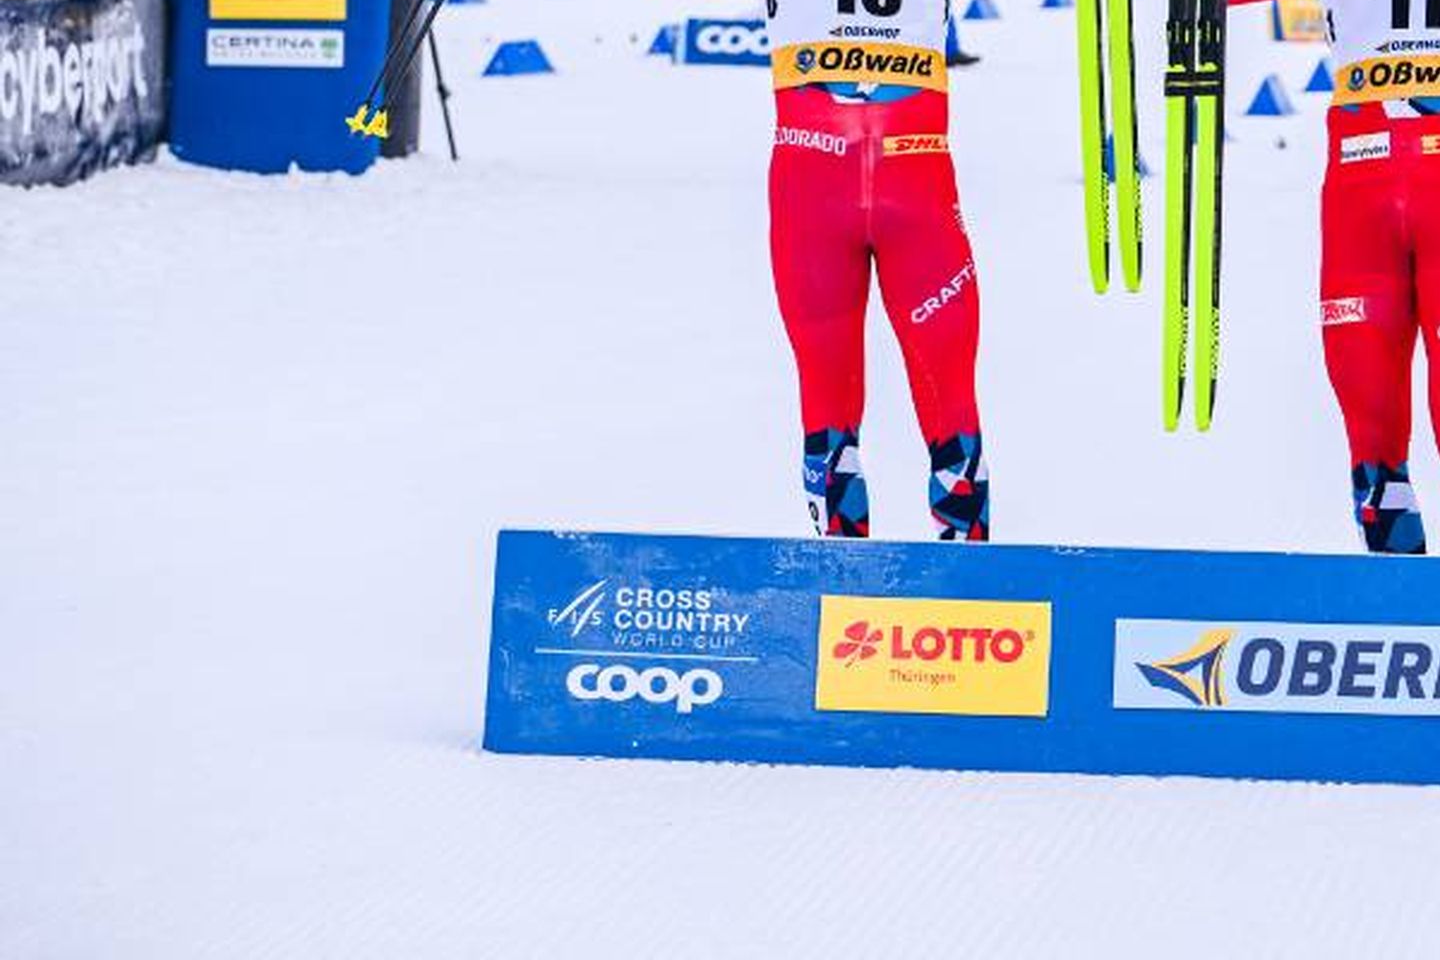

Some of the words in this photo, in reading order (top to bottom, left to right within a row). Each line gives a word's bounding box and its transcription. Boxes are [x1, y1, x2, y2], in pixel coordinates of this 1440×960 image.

[212, 34, 316, 49] CERTINA
[894, 138, 942, 152] DHL
[911, 266, 977, 324] CRAFT
[616, 588, 711, 609] CROSS
[614, 609, 749, 633] COUNTRY
[612, 631, 683, 647] WORLD
[694, 635, 736, 650] CUP
[891, 625, 1024, 663] LOTTO
[566, 664, 723, 714] coop
